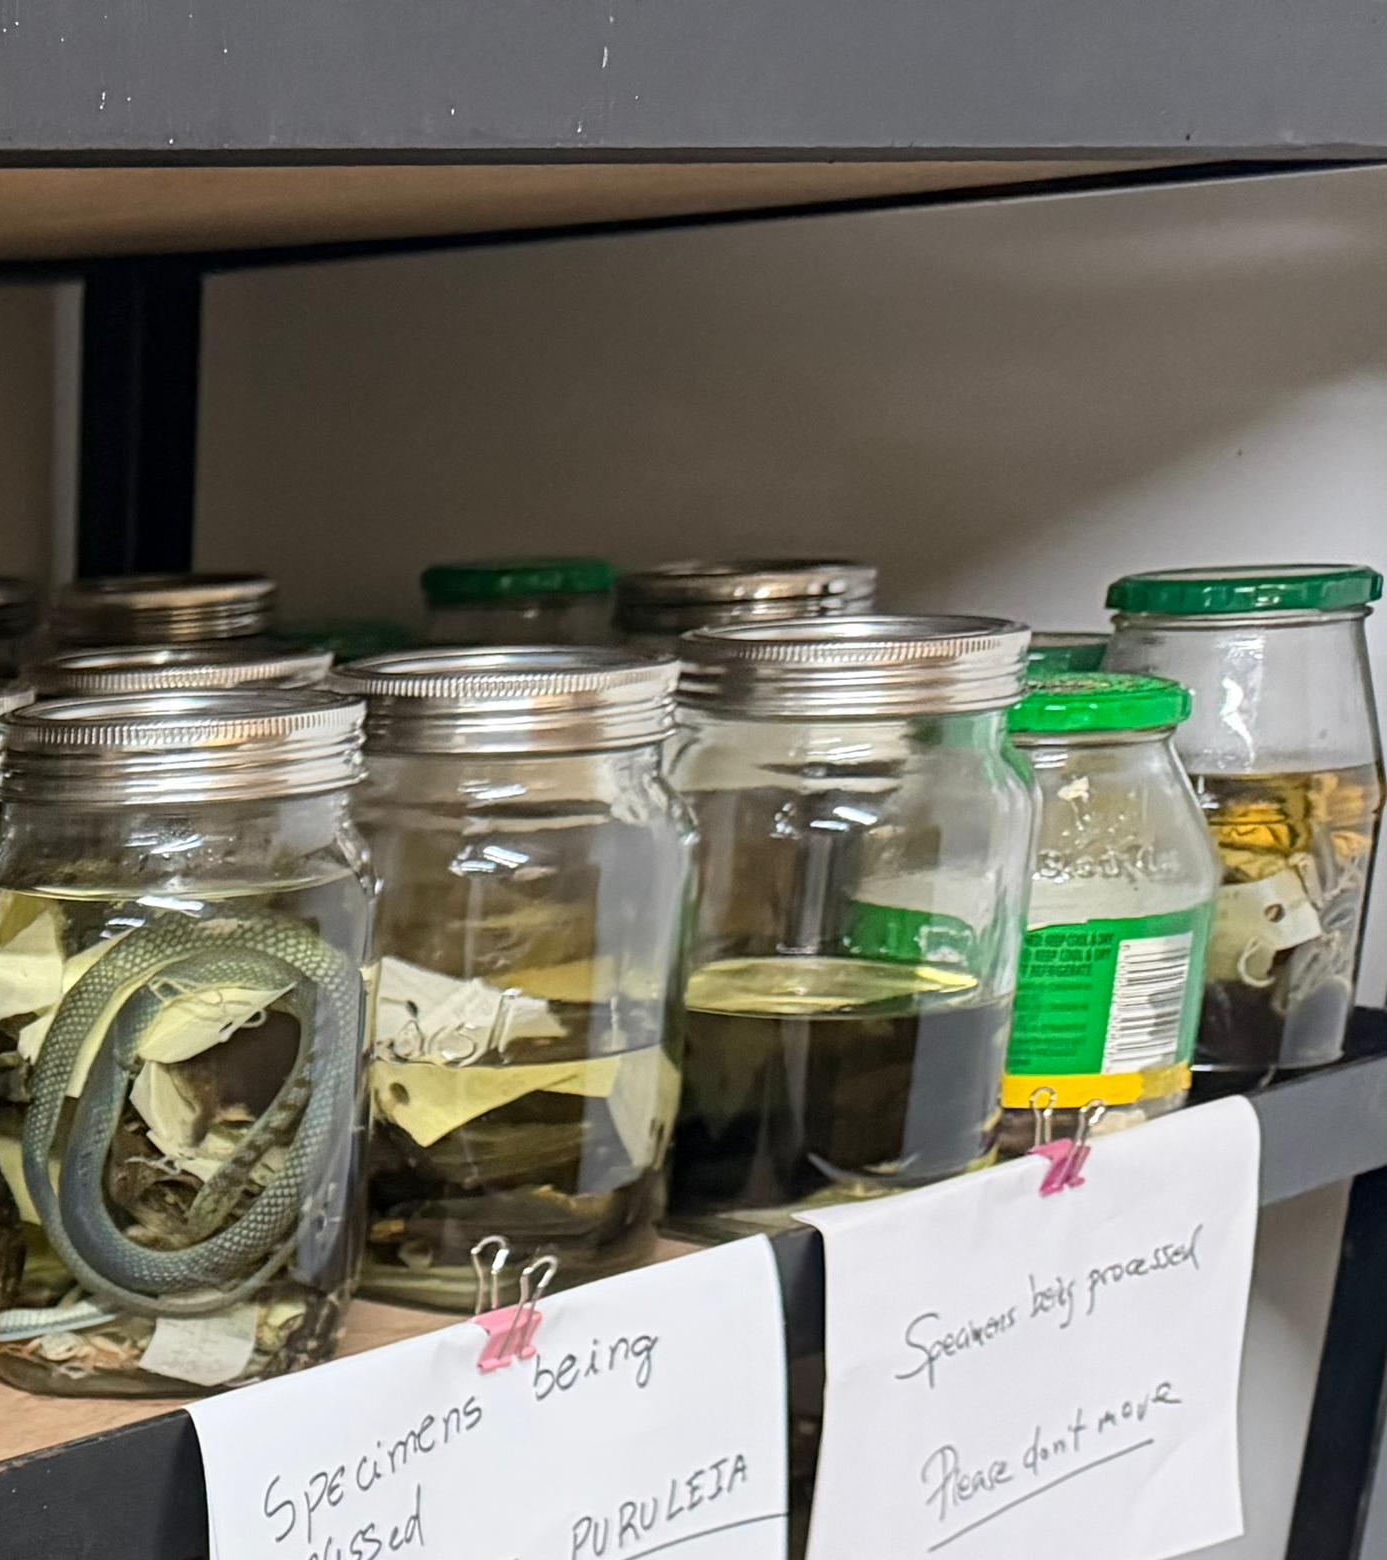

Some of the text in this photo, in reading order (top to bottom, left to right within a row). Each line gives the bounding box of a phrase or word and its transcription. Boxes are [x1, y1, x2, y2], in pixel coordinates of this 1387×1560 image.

[263, 1333, 659, 1544] Specimens being
[920, 1443, 1014, 1522] Please
[1097, 1380, 1182, 1434] move
